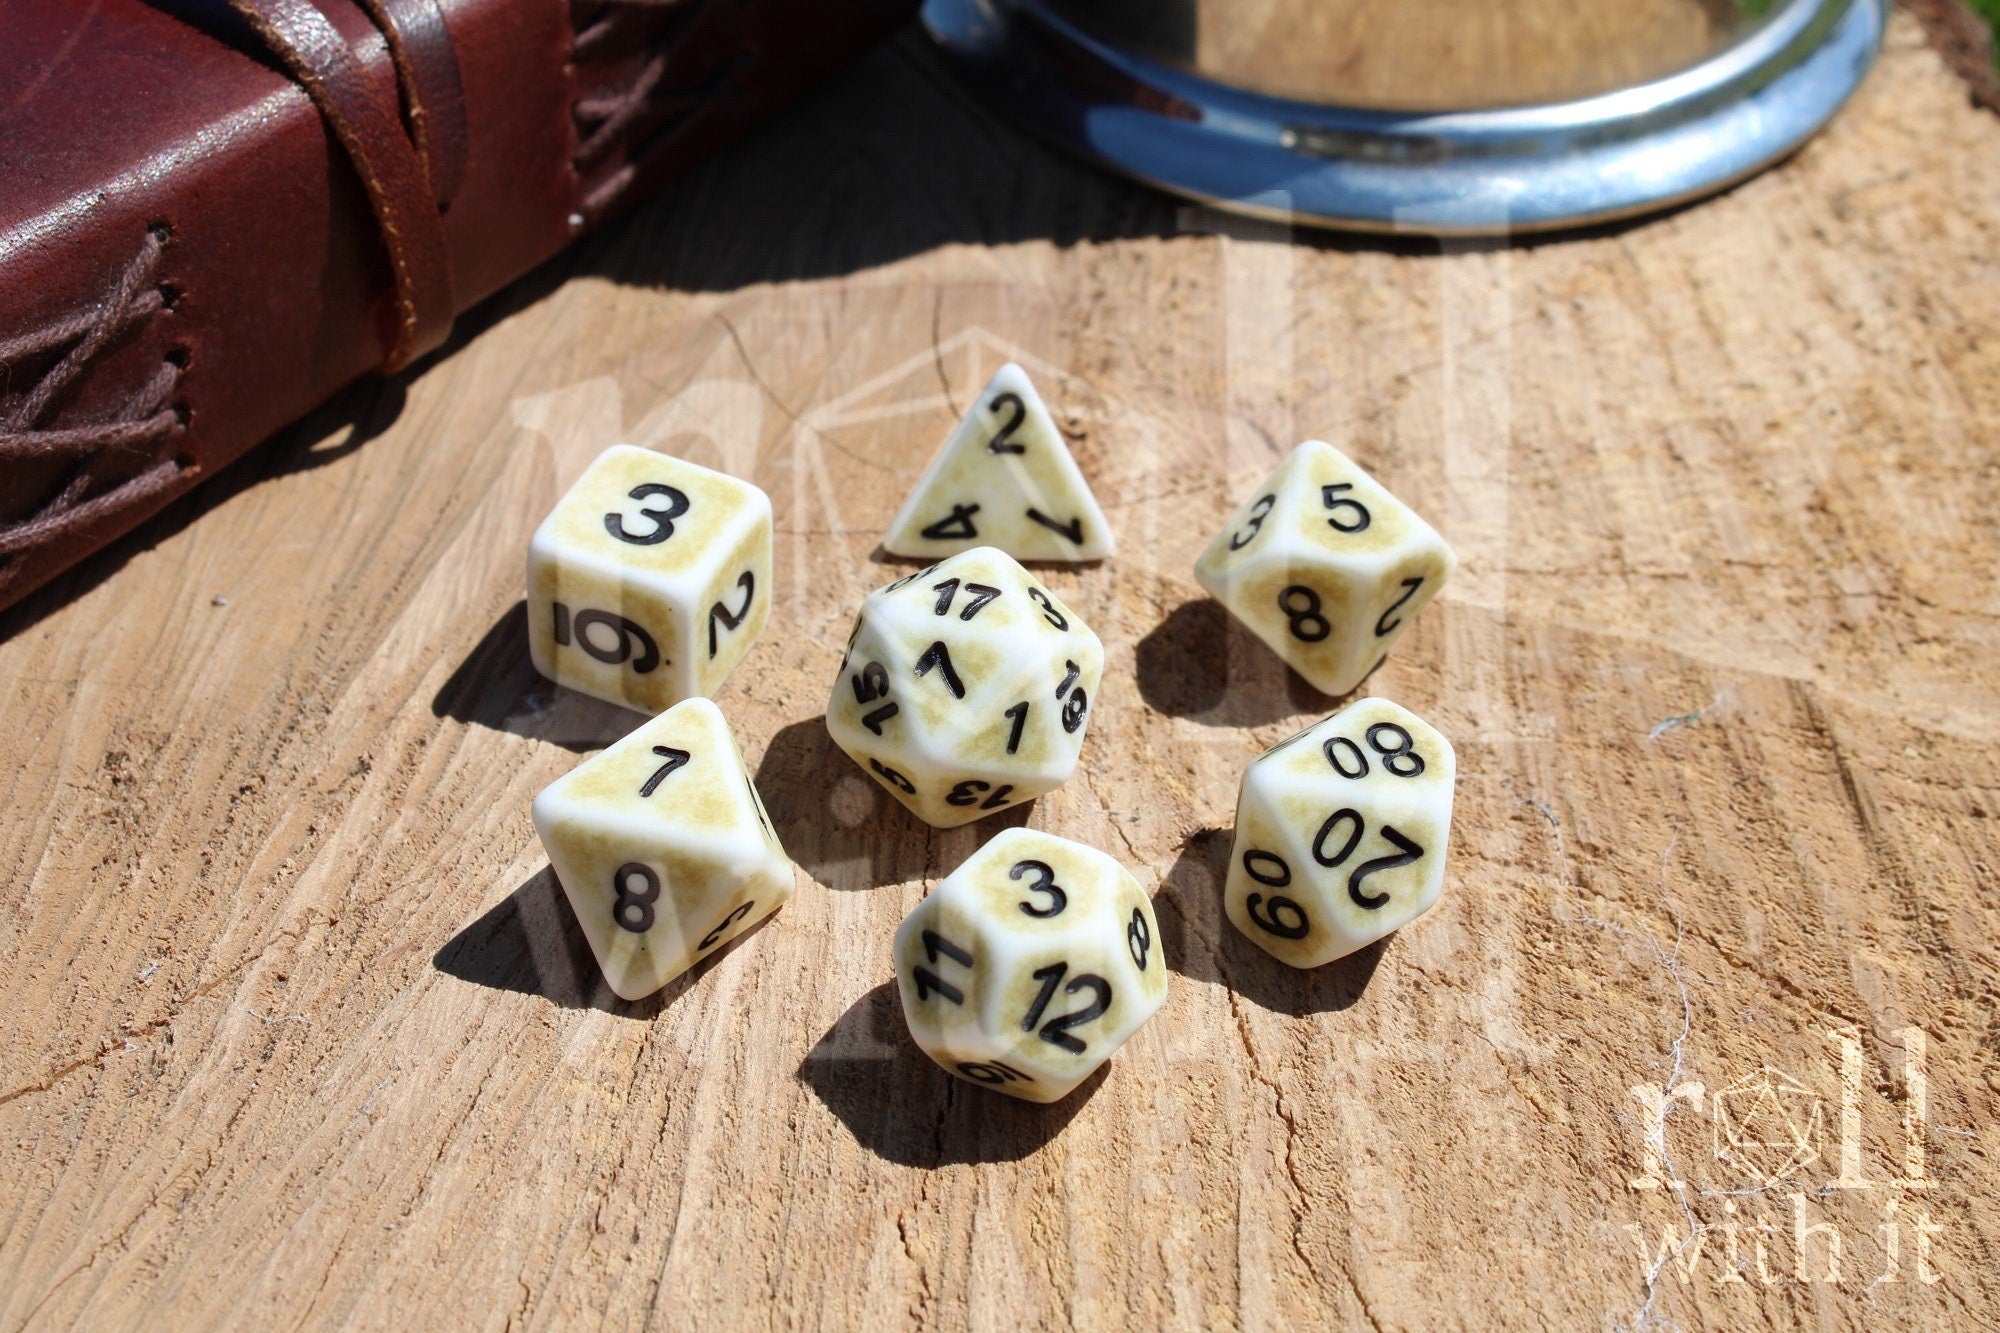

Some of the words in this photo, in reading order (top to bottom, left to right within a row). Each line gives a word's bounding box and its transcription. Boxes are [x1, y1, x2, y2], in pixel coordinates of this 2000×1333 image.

[989, 393, 1026, 454] 2
[604, 483, 690, 546] 3
[920, 504, 980, 540] 4
[1026, 508, 1083, 545] 1
[1229, 494, 1276, 551] 3
[1321, 483, 1371, 533] 5
[709, 571, 755, 660] 2
[932, 577, 1002, 621] 17
[1028, 587, 1069, 632] 3
[1278, 585, 1330, 642] 8
[1375, 577, 1424, 637] 2
[852, 661, 899, 736] 15
[1004, 701, 1029, 755] 1
[1323, 722, 1425, 780] 80
[639, 746, 691, 797] 7
[945, 780, 1013, 810] 13
[1313, 808, 1424, 910] 20
[613, 863, 660, 933] 8
[1010, 860, 1067, 918] 3
[912, 929, 974, 1006] 11
[1128, 907, 1149, 971] 8
[1022, 961, 1112, 1055] 12
